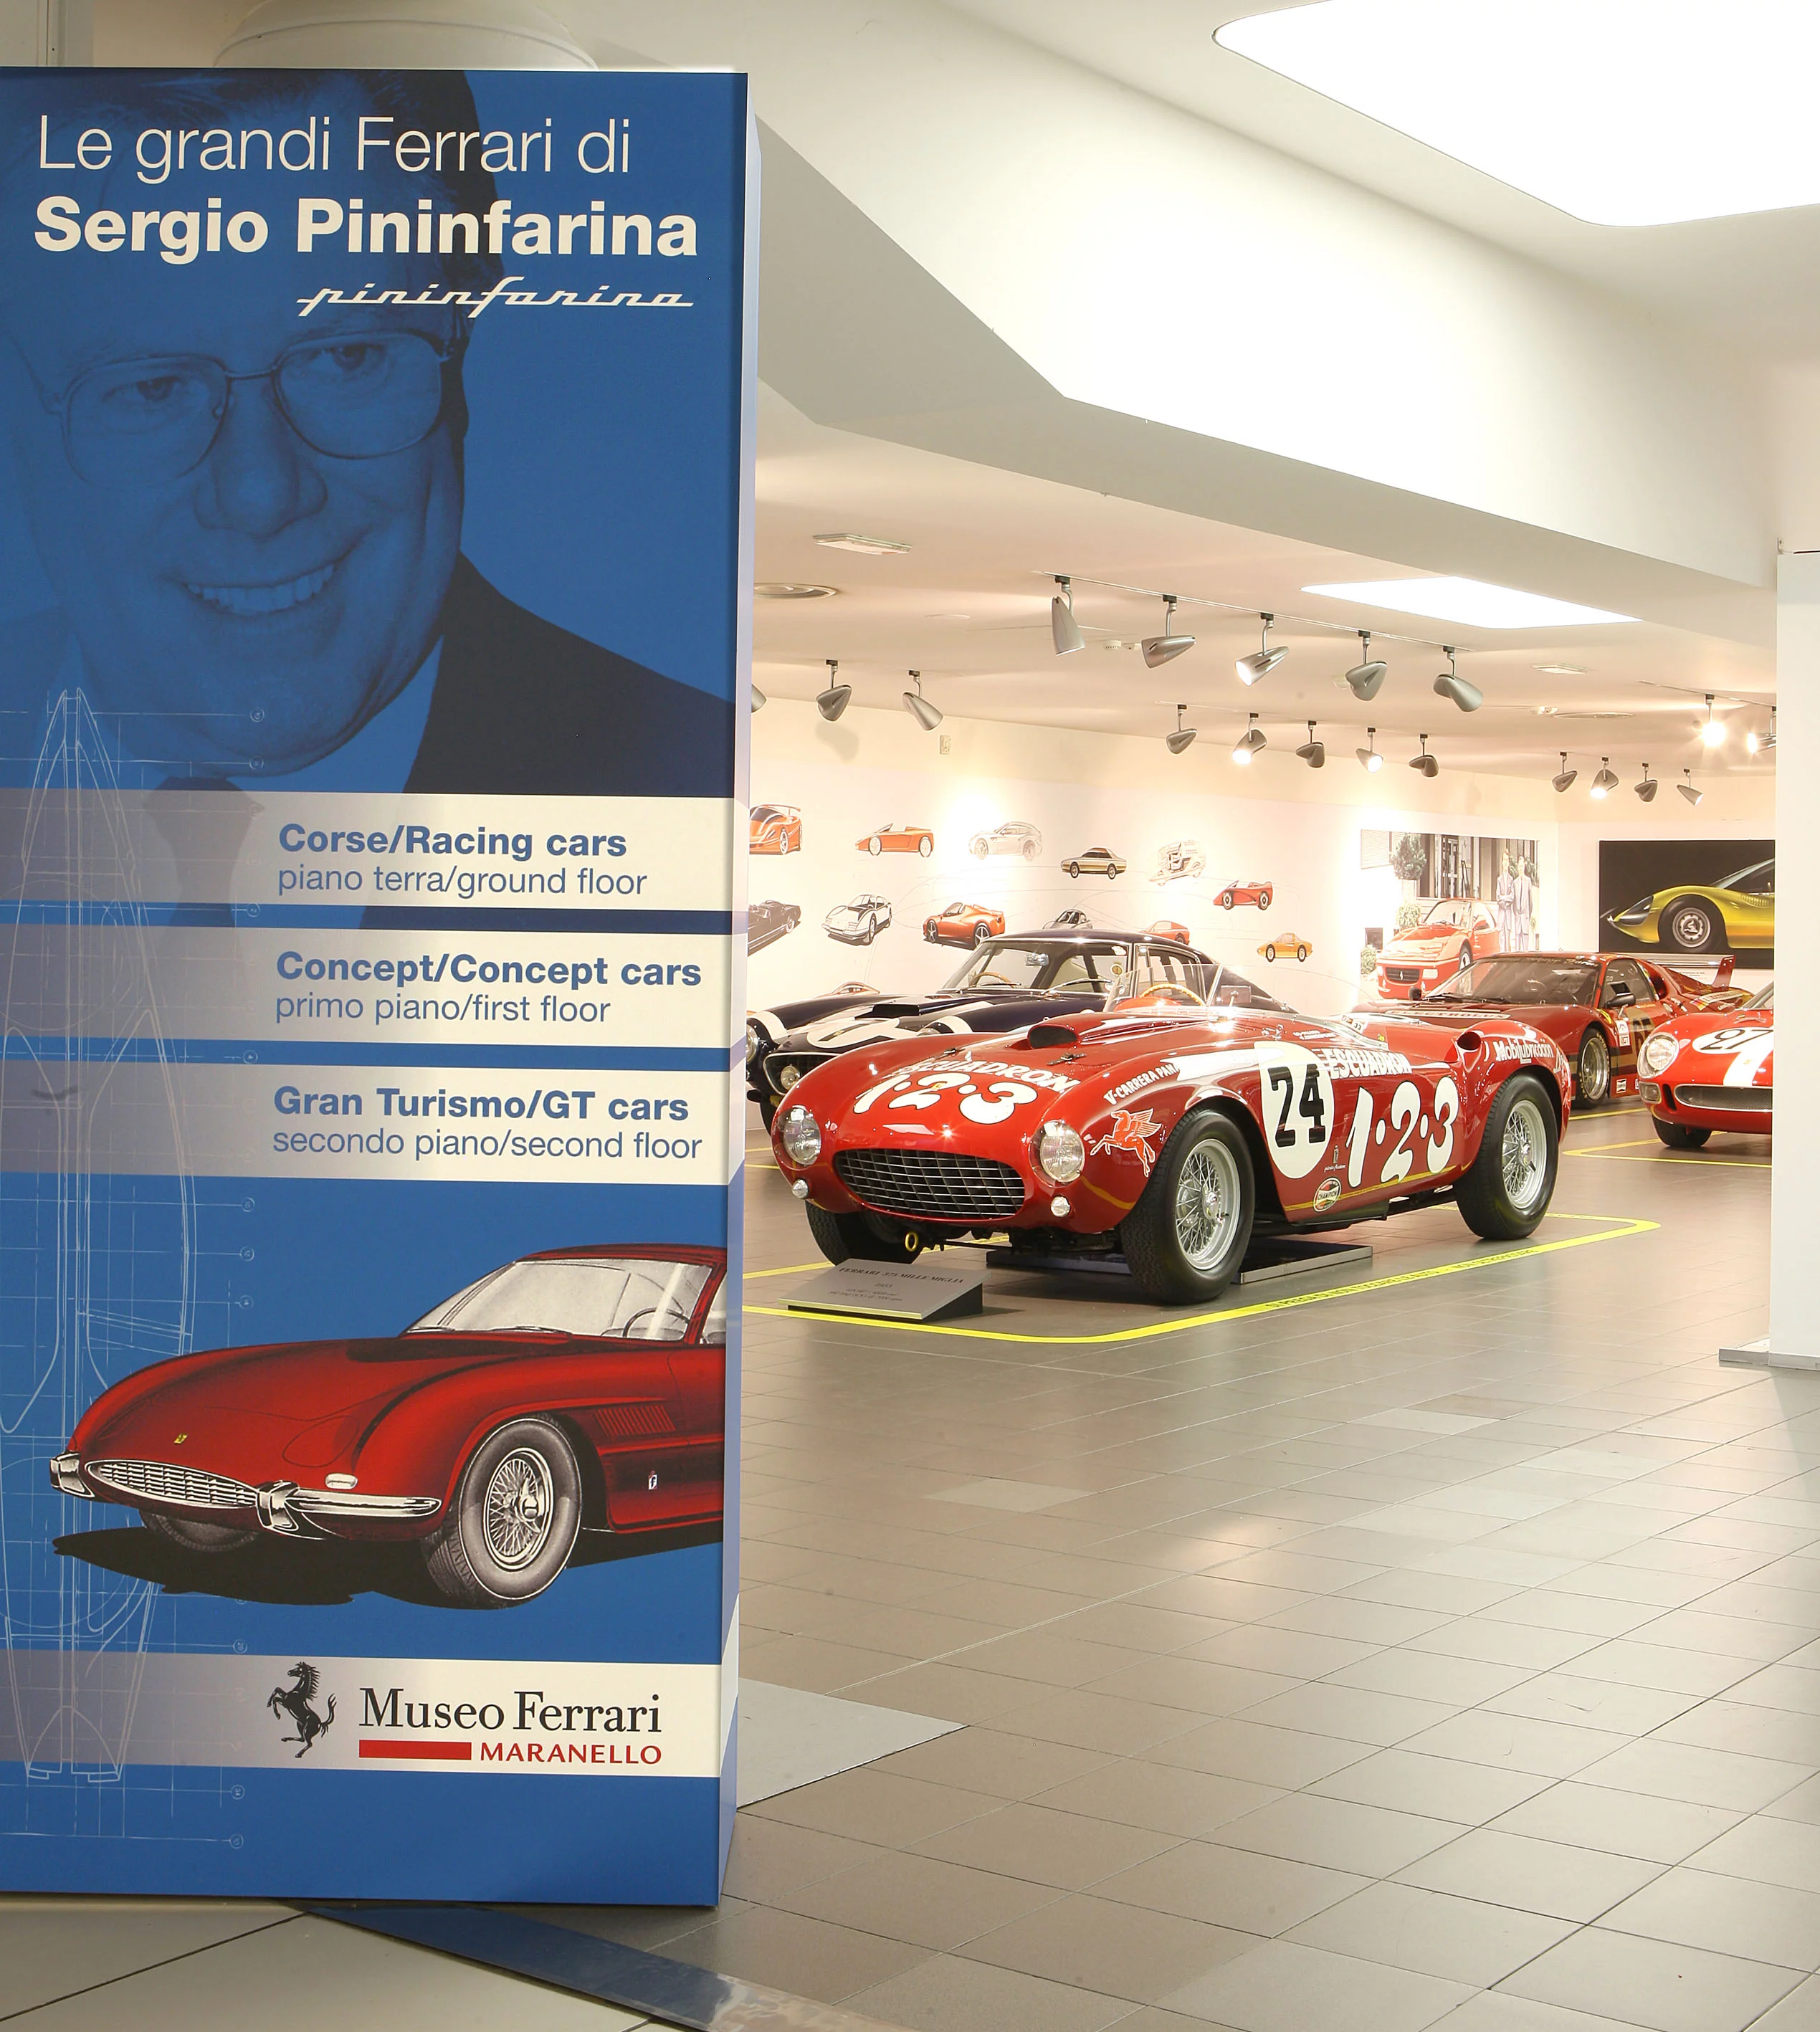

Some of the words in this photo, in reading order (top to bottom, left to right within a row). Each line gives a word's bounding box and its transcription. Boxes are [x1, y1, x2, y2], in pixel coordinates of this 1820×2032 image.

[40, 115, 112, 169] Le
[136, 117, 329, 184] grandi
[358, 117, 551, 173] Ferrari
[578, 119, 629, 173] di
[34, 196, 268, 265] Sergio
[297, 199, 697, 256] Pininfarina
[296, 277, 694, 318] pininfarina
[279, 823, 532, 861] Corse/Racing
[547, 834, 626, 857] cars
[279, 864, 362, 896] piano
[374, 866, 566, 899] terra/ground
[577, 867, 647, 894] floor
[276, 951, 607, 990] Concept/Concept
[621, 963, 701, 986] cars
[276, 992, 363, 1024] primo
[375, 993, 530, 1025] piano/first
[540, 996, 611, 1022] floor
[1321, 1048, 1412, 1079] ESCUADRON
[274, 1085, 362, 1115] Gran
[376, 1087, 595, 1119] Turismo/GT
[609, 1098, 688, 1120] cars
[1267, 1064, 1325, 1148] 24
[273, 1127, 404, 1154] secondo
[415, 1130, 622, 1160] piano/second
[634, 1132, 702, 1158] floor
[359, 1687, 505, 1730] Museo
[513, 1692, 662, 1732] Ferrari
[480, 1742, 662, 1765] MARANELLO
